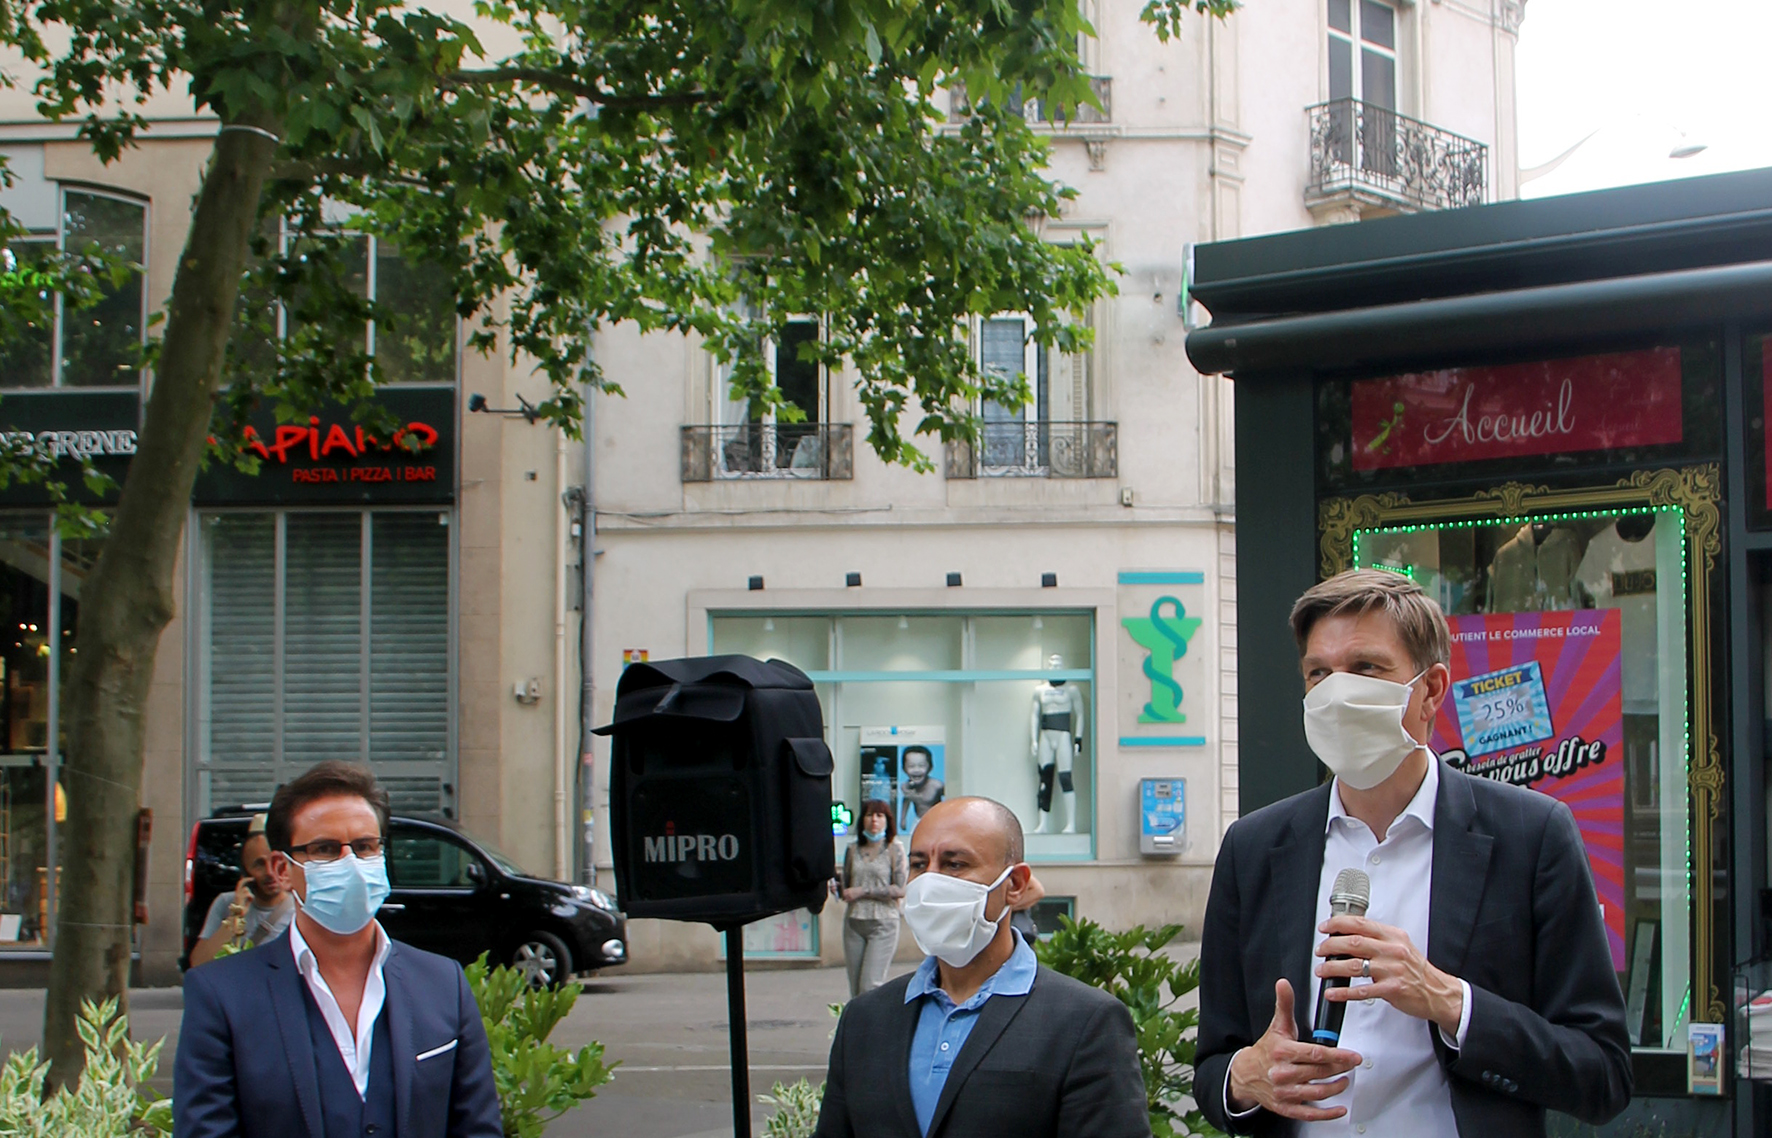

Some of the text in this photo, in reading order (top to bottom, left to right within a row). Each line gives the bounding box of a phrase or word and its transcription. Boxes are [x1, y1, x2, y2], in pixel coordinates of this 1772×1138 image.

[1424, 378, 1575, 444] Accueil
[36, 430, 138, 462] GRENE
[292, 466, 436, 483] PASTA PIZZA BAR
[1489, 630, 1501, 641] LE
[1504, 627, 1563, 640] COMMERCE
[1566, 625, 1601, 637] LOCAL
[1470, 671, 1522, 695] TICKET
[1481, 697, 1525, 722] 25%
[1466, 757, 1496, 773] besoin
[1497, 751, 1508, 766] de
[1508, 746, 1542, 766] gratter
[1488, 736, 1601, 783] vous offre
[644, 821, 740, 862] MIPRO
